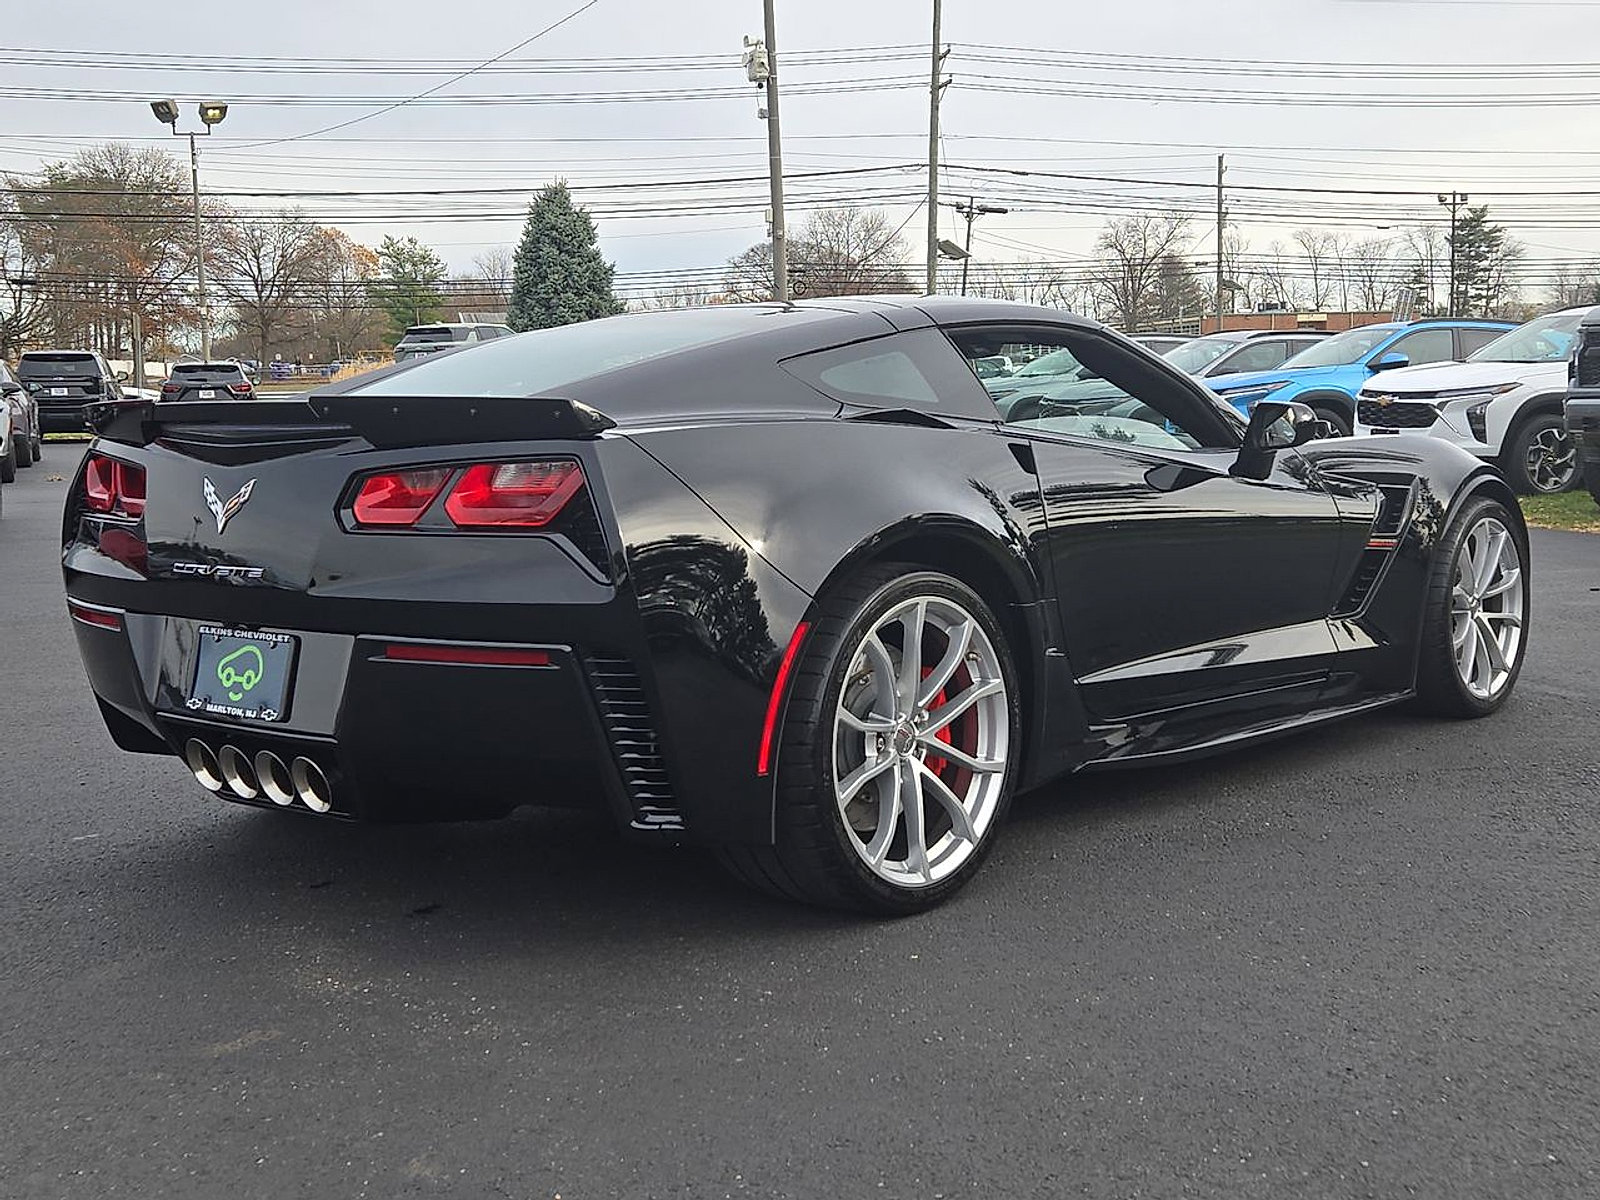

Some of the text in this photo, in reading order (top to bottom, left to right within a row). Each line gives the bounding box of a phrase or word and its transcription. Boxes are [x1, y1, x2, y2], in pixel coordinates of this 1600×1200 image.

[199, 626, 290, 642] ELKINS CHEVROLET
[206, 704, 257, 718] MARLTON, NJ
